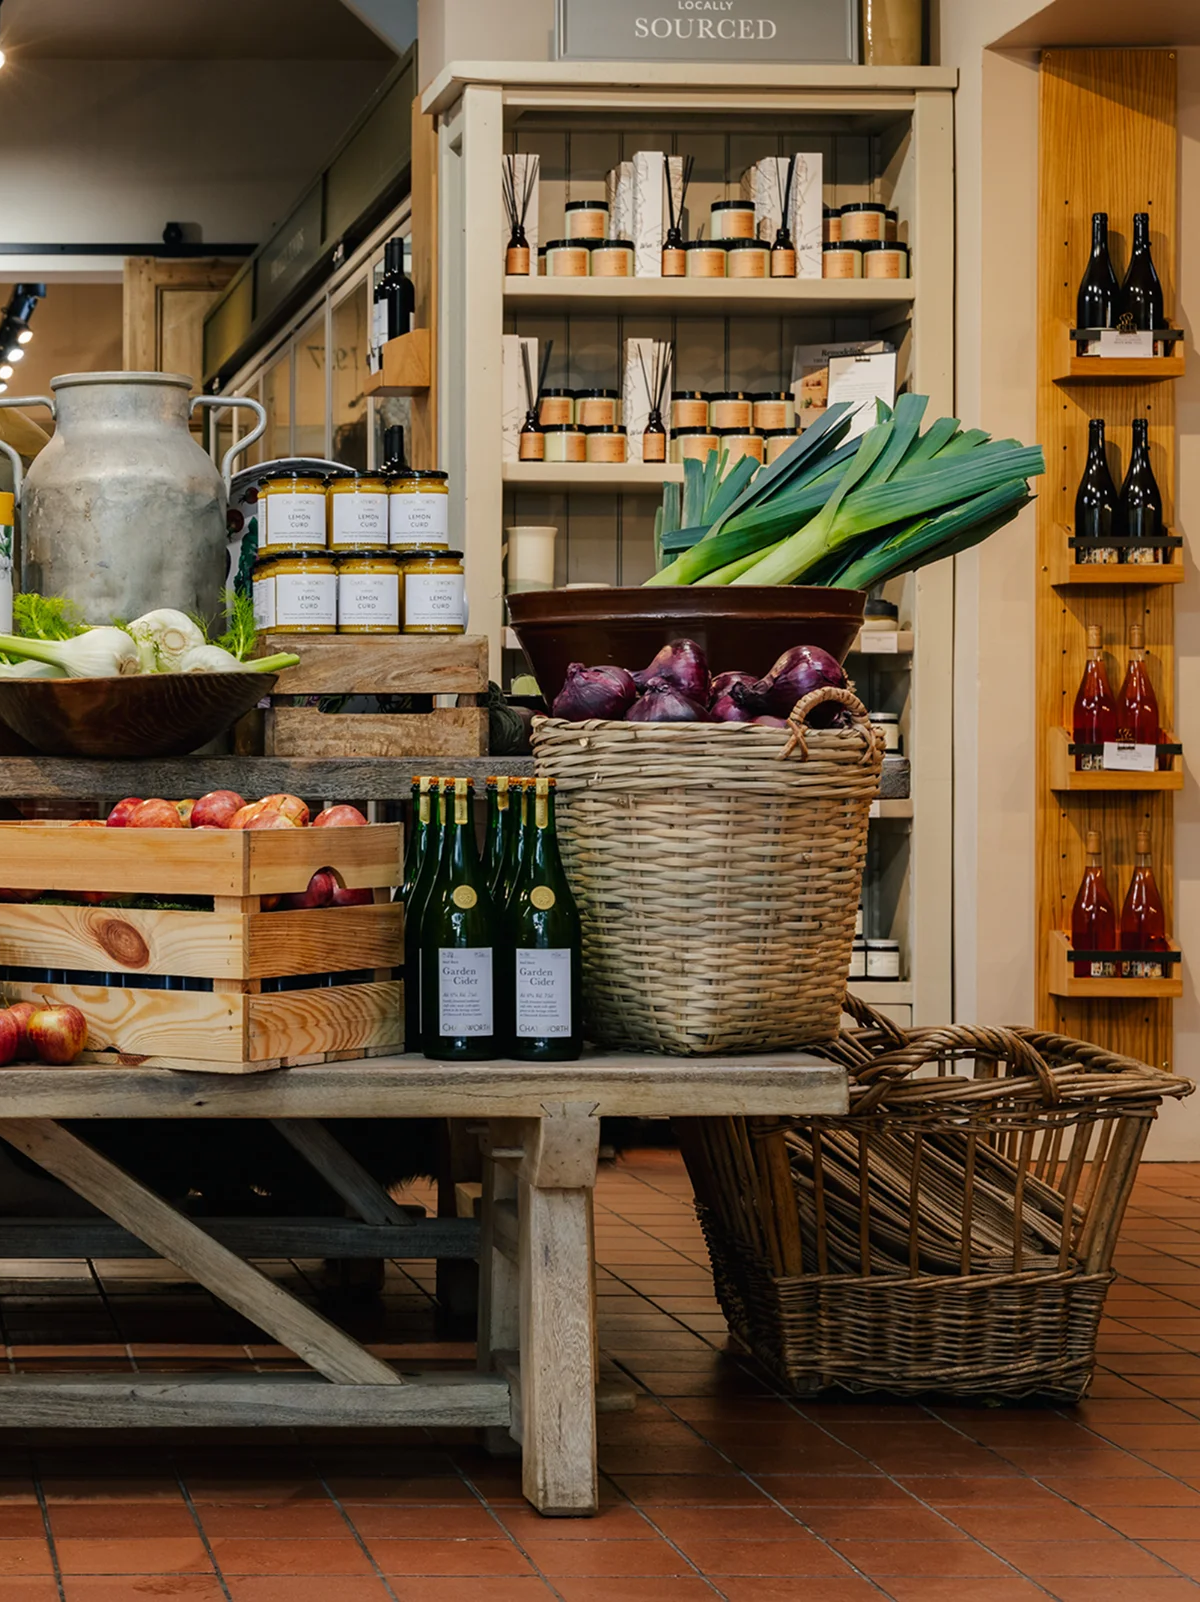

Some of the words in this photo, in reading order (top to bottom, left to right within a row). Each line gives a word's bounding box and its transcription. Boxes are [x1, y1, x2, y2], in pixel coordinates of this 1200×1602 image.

[678, 1, 733, 11] LOCALLY
[635, 17, 777, 39] SOURCED
[442, 967, 476, 976] Garden
[520, 967, 553, 977] Garden
[453, 976, 478, 985] Cider
[529, 977, 555, 986] Cider
